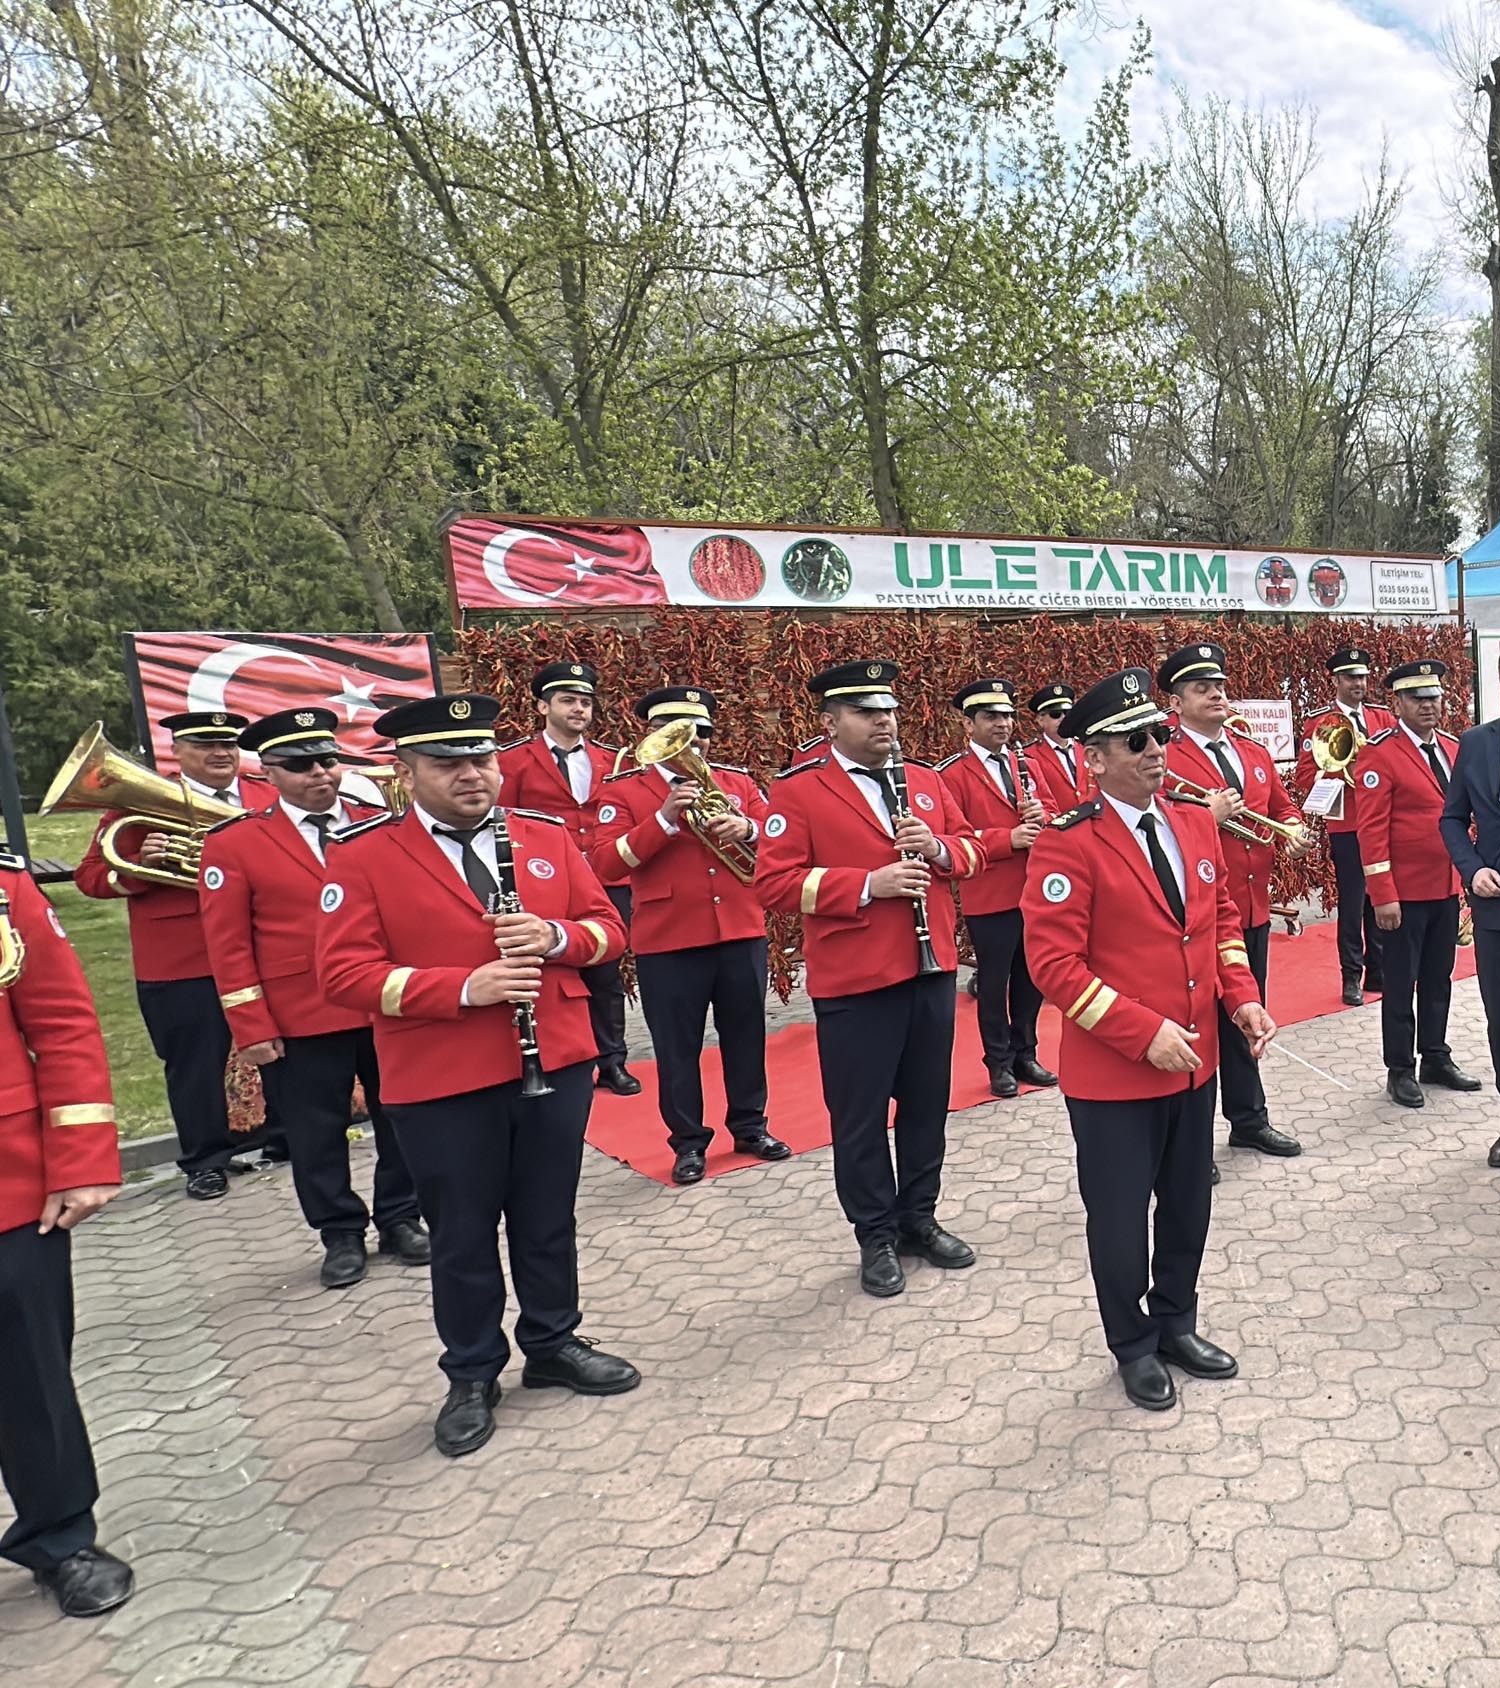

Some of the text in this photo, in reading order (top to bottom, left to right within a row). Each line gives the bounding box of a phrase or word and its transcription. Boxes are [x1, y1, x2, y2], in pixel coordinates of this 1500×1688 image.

[894, 542, 1227, 596] ULE TARIM
[1379, 585, 1396, 593] 0535
[876, 591, 950, 605] PATENTLİ
[1040, 592, 1080, 606] CİĞER
[1085, 593, 1127, 606] BİBERİ
[1140, 596, 1195, 608] YÖRESEL
[1200, 598, 1218, 608] ACI
[1221, 598, 1244, 608] SOS
[1380, 597, 1397, 605] 0546
[1398, 597, 1410, 605] 504
[1263, 708, 1288, 719] KALBİ
